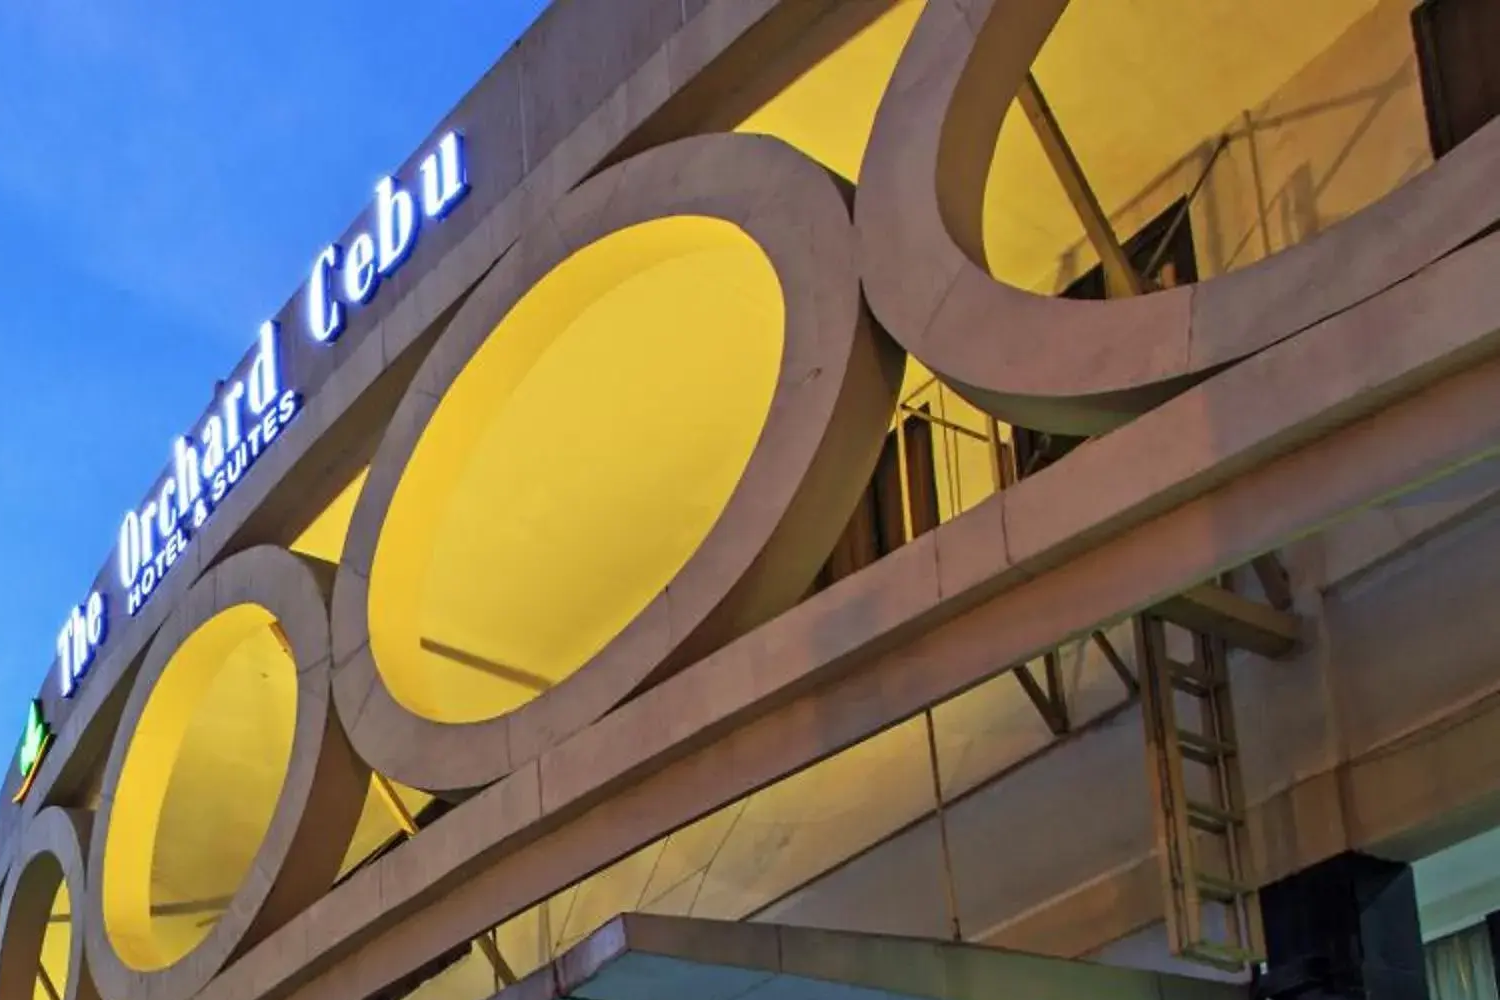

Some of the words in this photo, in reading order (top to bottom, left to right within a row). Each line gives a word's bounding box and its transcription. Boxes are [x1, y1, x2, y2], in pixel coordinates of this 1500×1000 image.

[55, 589, 107, 697] The
[117, 320, 282, 588] Orchard
[308, 132, 468, 341] Cebu
[128, 528, 187, 615] HOTEL
[194, 499, 208, 527] &
[213, 390, 296, 500] SUITES
